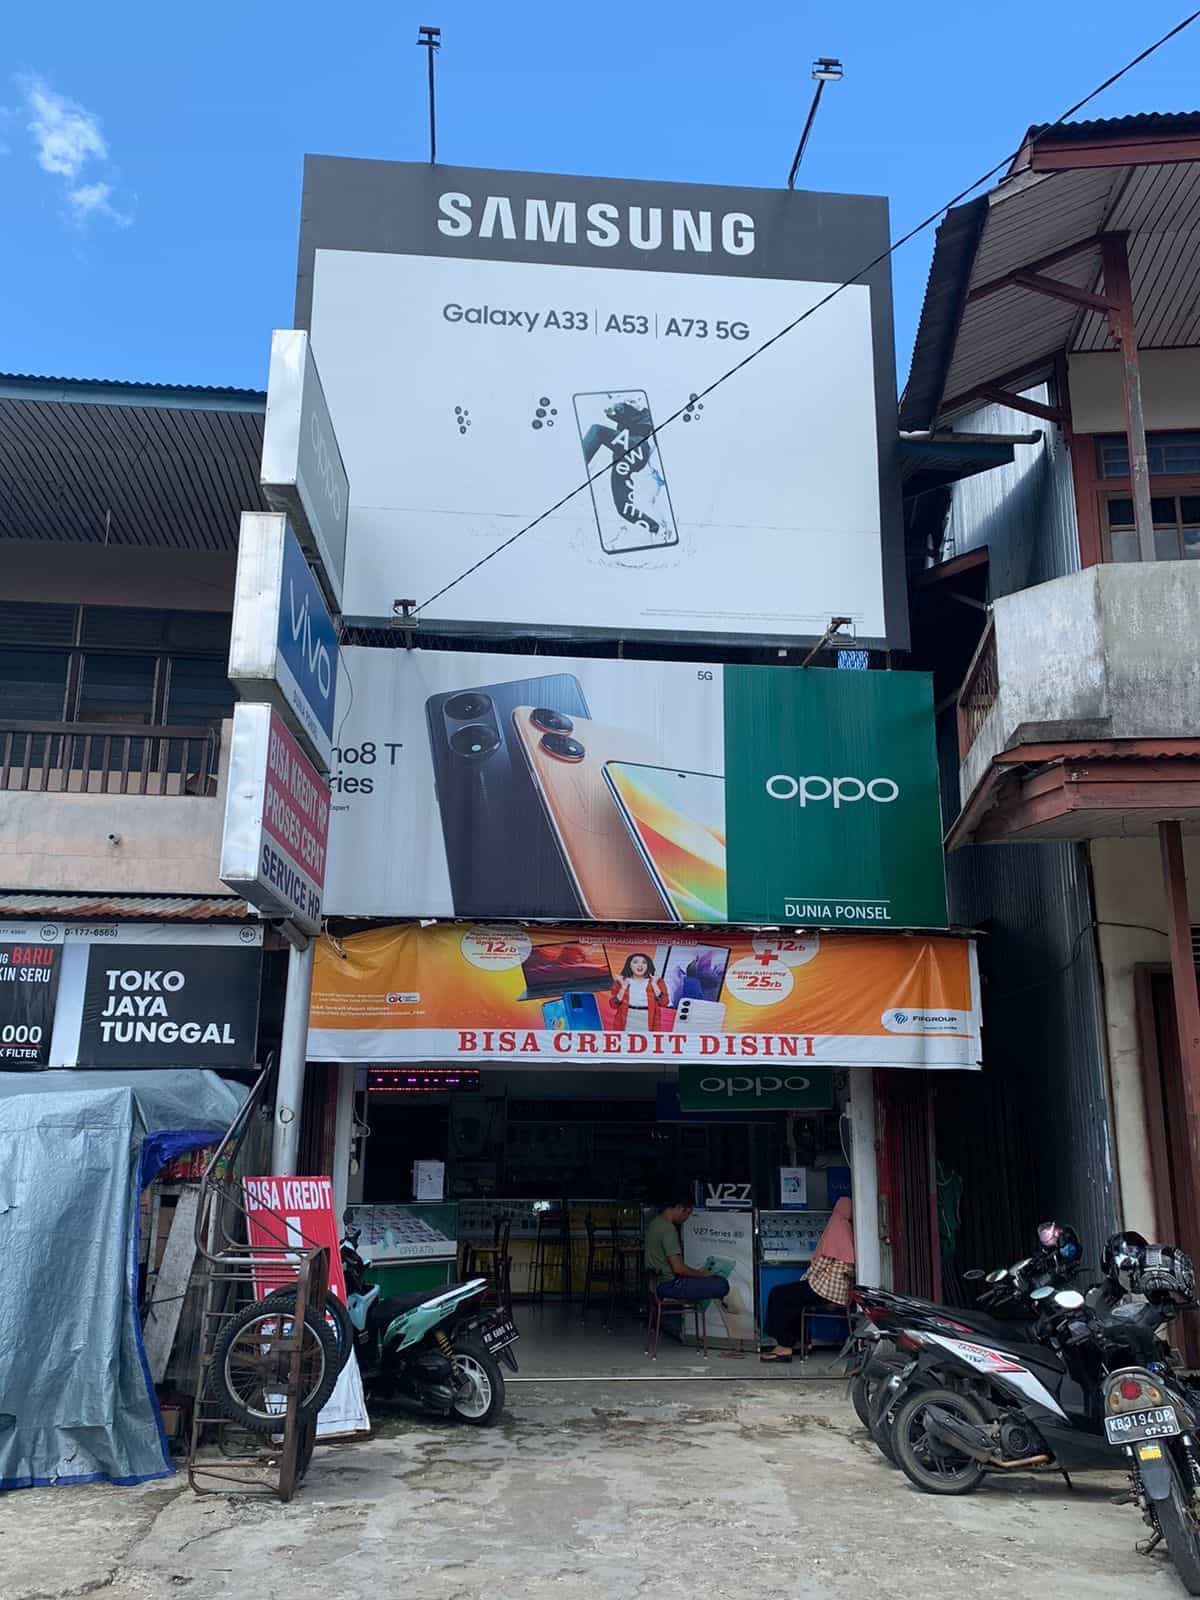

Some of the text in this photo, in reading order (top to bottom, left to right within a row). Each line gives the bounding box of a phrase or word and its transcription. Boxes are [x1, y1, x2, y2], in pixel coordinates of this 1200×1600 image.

[437, 191, 756, 256] SAMSUNG
[443, 303, 750, 342] Galaxy A33 A53 A73 5G
[289, 577, 331, 699] vivo
[697, 670, 713, 682] 5G
[384, 743, 403, 765] T
[269, 731, 290, 786] BISA
[290, 760, 318, 818] KREDIT
[765, 774, 899, 808] oppo
[265, 784, 301, 850] PROSES
[261, 843, 321, 921] SERVICE HP
[784, 904, 891, 920] DUNIA PONSEL
[12, 946, 54, 967] BARU
[19, 967, 51, 983] SERU
[106, 970, 186, 992] TOKO
[102, 996, 169, 1017] JAYA
[100, 1021, 236, 1045] TUNGGAL
[457, 1031, 816, 1057] BISA CREDIT DISINI
[6, 1048, 38, 1059] FILTER
[700, 1076, 811, 1097] oppo
[247, 1180, 332, 1211] BISA KREDIT
[707, 1183, 753, 1200] V27
[709, 1227, 732, 1238] Series
